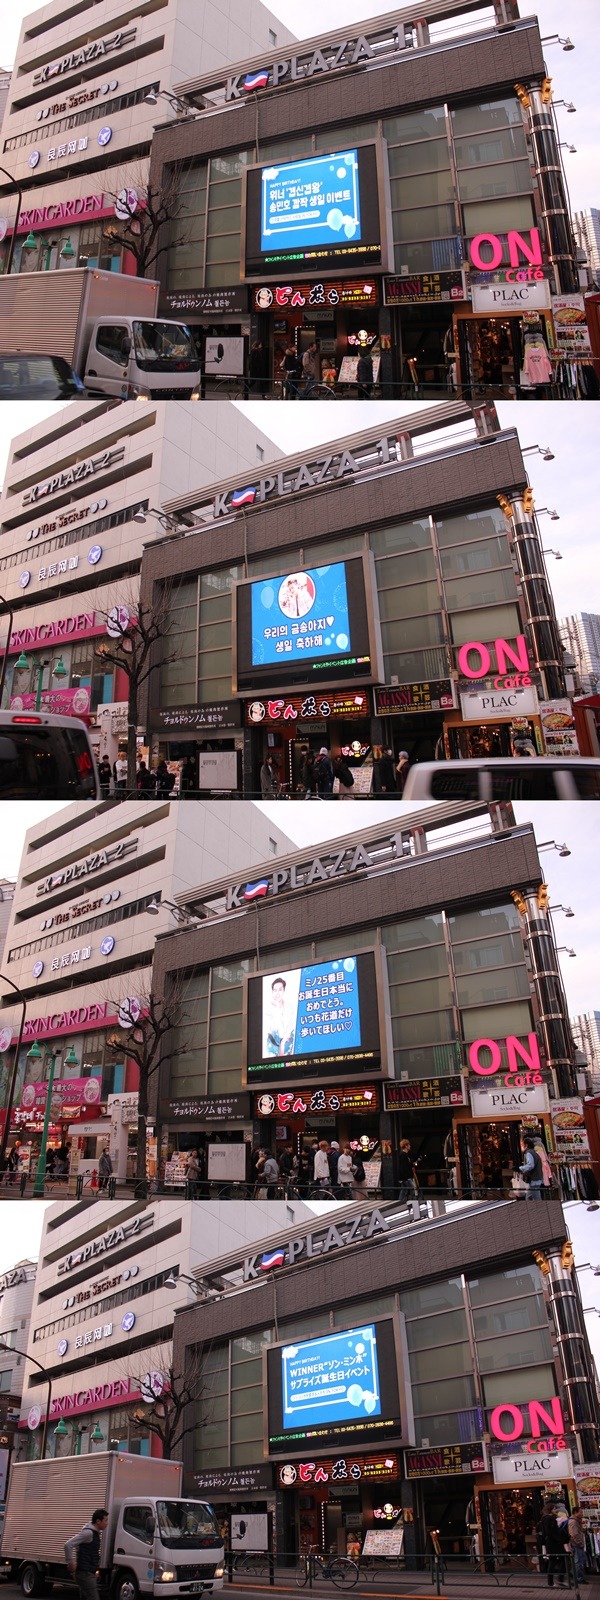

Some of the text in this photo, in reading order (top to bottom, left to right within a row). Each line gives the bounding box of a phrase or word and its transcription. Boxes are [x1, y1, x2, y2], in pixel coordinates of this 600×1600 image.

[39, 32, 122, 82] K PLAZA 2
[225, 22, 406, 100] K PLAZA 1
[51, 102, 67, 116] THE
[69, 88, 100, 108] SECRET
[269, 199, 291, 213] 송민호
[309, 194, 325, 208] 생일
[326, 190, 352, 204] 이벤트
[270, 188, 285, 200] 위너
[18, 192, 105, 226] SKINGARDEN
[470, 227, 544, 270] ON
[506, 266, 544, 282] Café
[388, 280, 421, 294] AGASSI
[451, 288, 464, 296] B2
[493, 289, 529, 302] PLAC
[30, 452, 111, 502] K PLAZA 2
[214, 437, 390, 517] K PLAZA 1
[41, 522, 56, 535] THE
[58, 507, 90, 528] SECRET
[10, 611, 96, 646] SKINGARDEN
[264, 618, 326, 640] 우리의 금송아지
[276, 635, 322, 653] 생일 축하해
[458, 634, 530, 678] ON
[494, 672, 532, 690] Café
[380, 690, 412, 706] AGASSI
[441, 696, 452, 705] B2
[482, 696, 518, 708] PLAC
[43, 843, 124, 892] K PLAZA 2
[226, 832, 404, 910] K PLAZA 1
[54, 913, 69, 926] THE
[72, 898, 103, 918] SECRET
[305, 972, 344, 987] ミノ25番目
[298, 982, 353, 1001] お誕生日本当に
[300, 1008, 352, 1024] いつも花道だけ
[306, 998, 344, 1012] おめでとう。
[23, 1001, 108, 1035] SKINGARDEN
[469, 1032, 541, 1076] ON
[504, 1070, 542, 1088] Café
[388, 1086, 420, 1100] AGASSI
[451, 1093, 463, 1102] B2
[492, 1093, 528, 1106] PLAC
[64, 1218, 142, 1272] K PLAZA 2
[243, 1201, 421, 1282] K PLAZA 1
[76, 1290, 90, 1303] THE
[92, 1274, 122, 1296] SECRET
[290, 1366, 370, 1390] サプライズ誕生日イベント
[51, 1378, 131, 1413] SKINGARDEN
[490, 1396, 564, 1442] ON
[527, 1436, 566, 1453] Café
[409, 1454, 442, 1468] AGASSI
[472, 1460, 484, 1468] B2
[514, 1458, 551, 1472] PLAC
